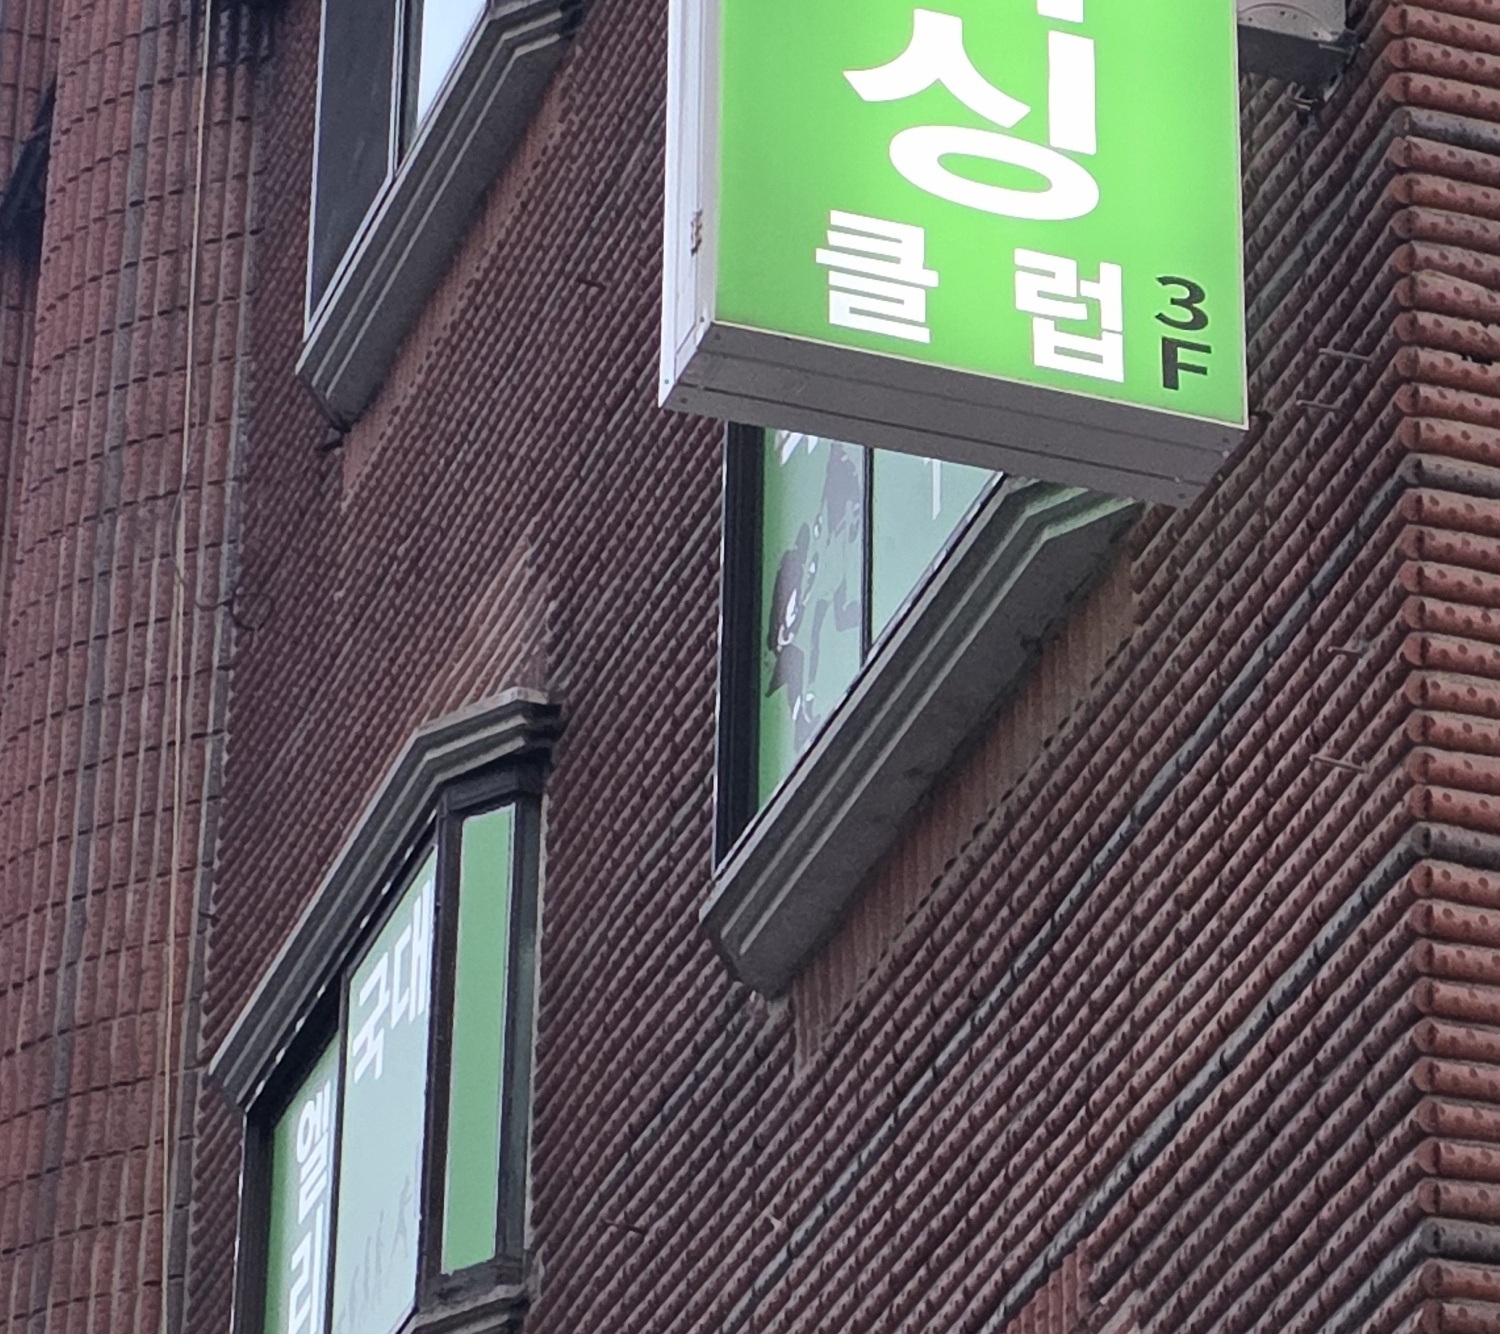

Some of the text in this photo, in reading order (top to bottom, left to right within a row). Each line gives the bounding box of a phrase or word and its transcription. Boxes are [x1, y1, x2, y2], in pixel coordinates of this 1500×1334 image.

[815, 208, 1126, 384] 클럽
[1155, 274, 1213, 392] 3F
[352, 879, 432, 1085] 국대
